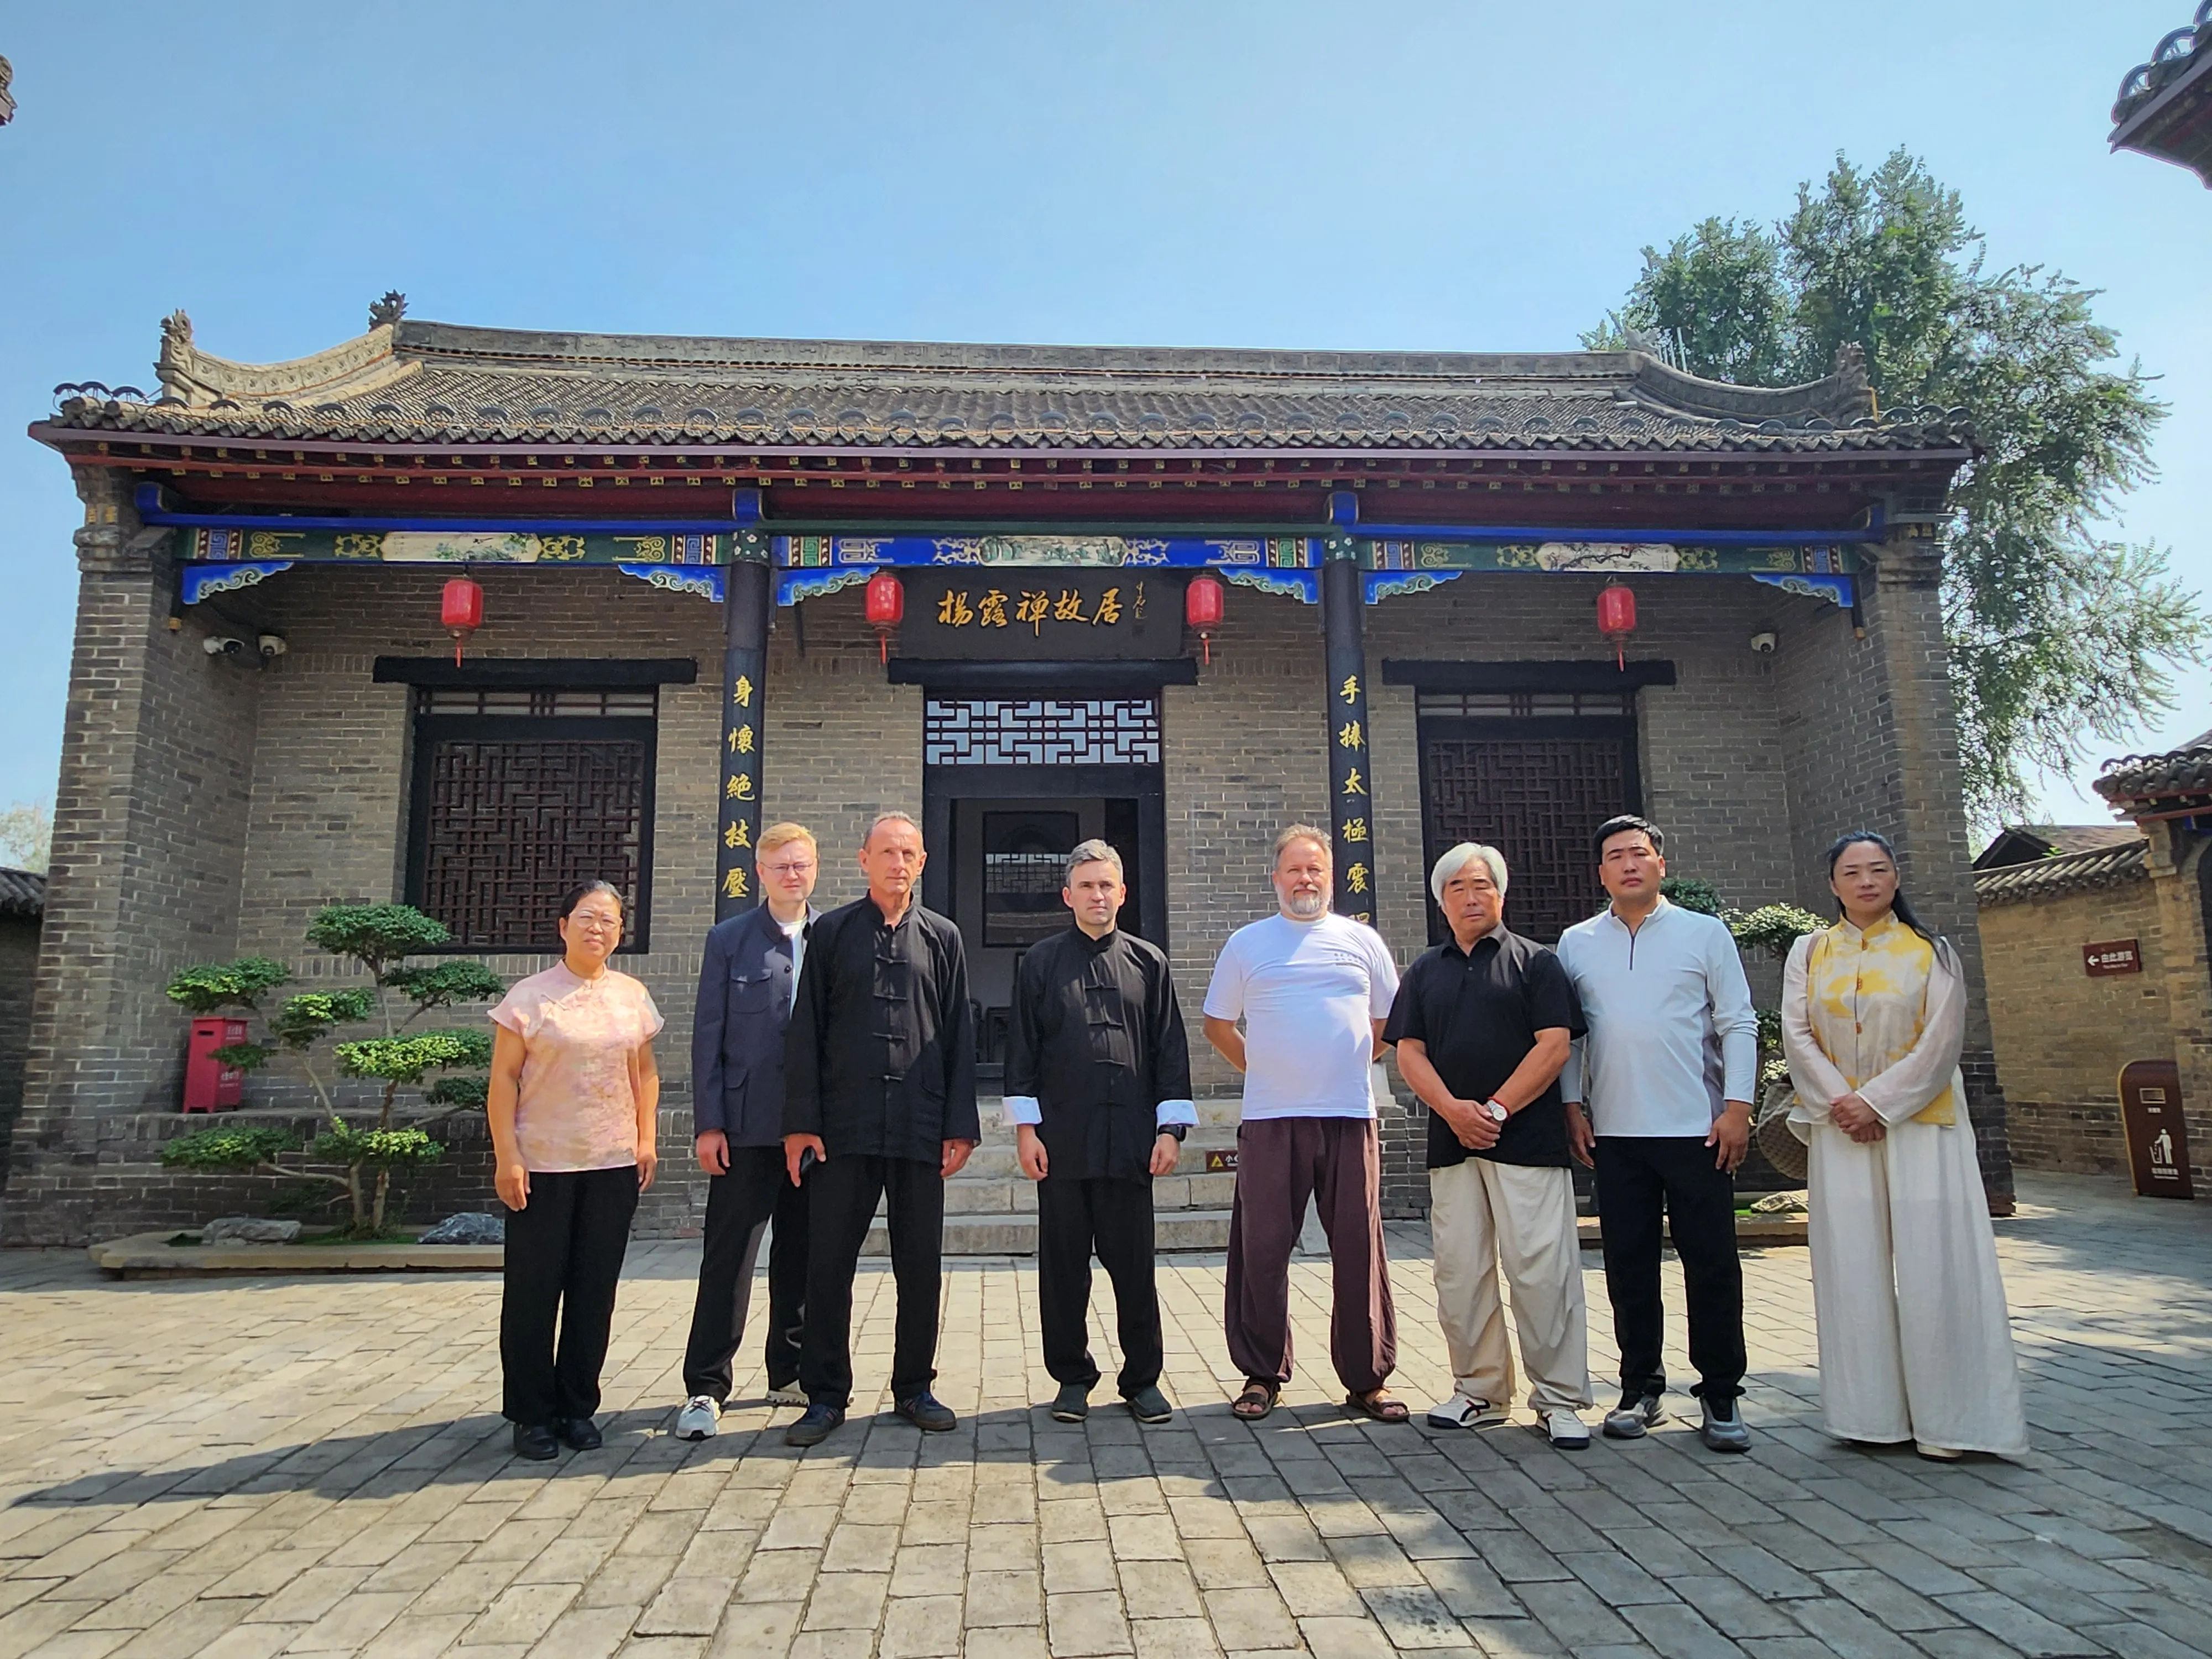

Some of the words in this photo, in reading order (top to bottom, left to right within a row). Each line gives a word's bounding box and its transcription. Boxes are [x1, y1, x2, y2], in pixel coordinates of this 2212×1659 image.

[1339, 675, 1370, 923] 手捧太極震
